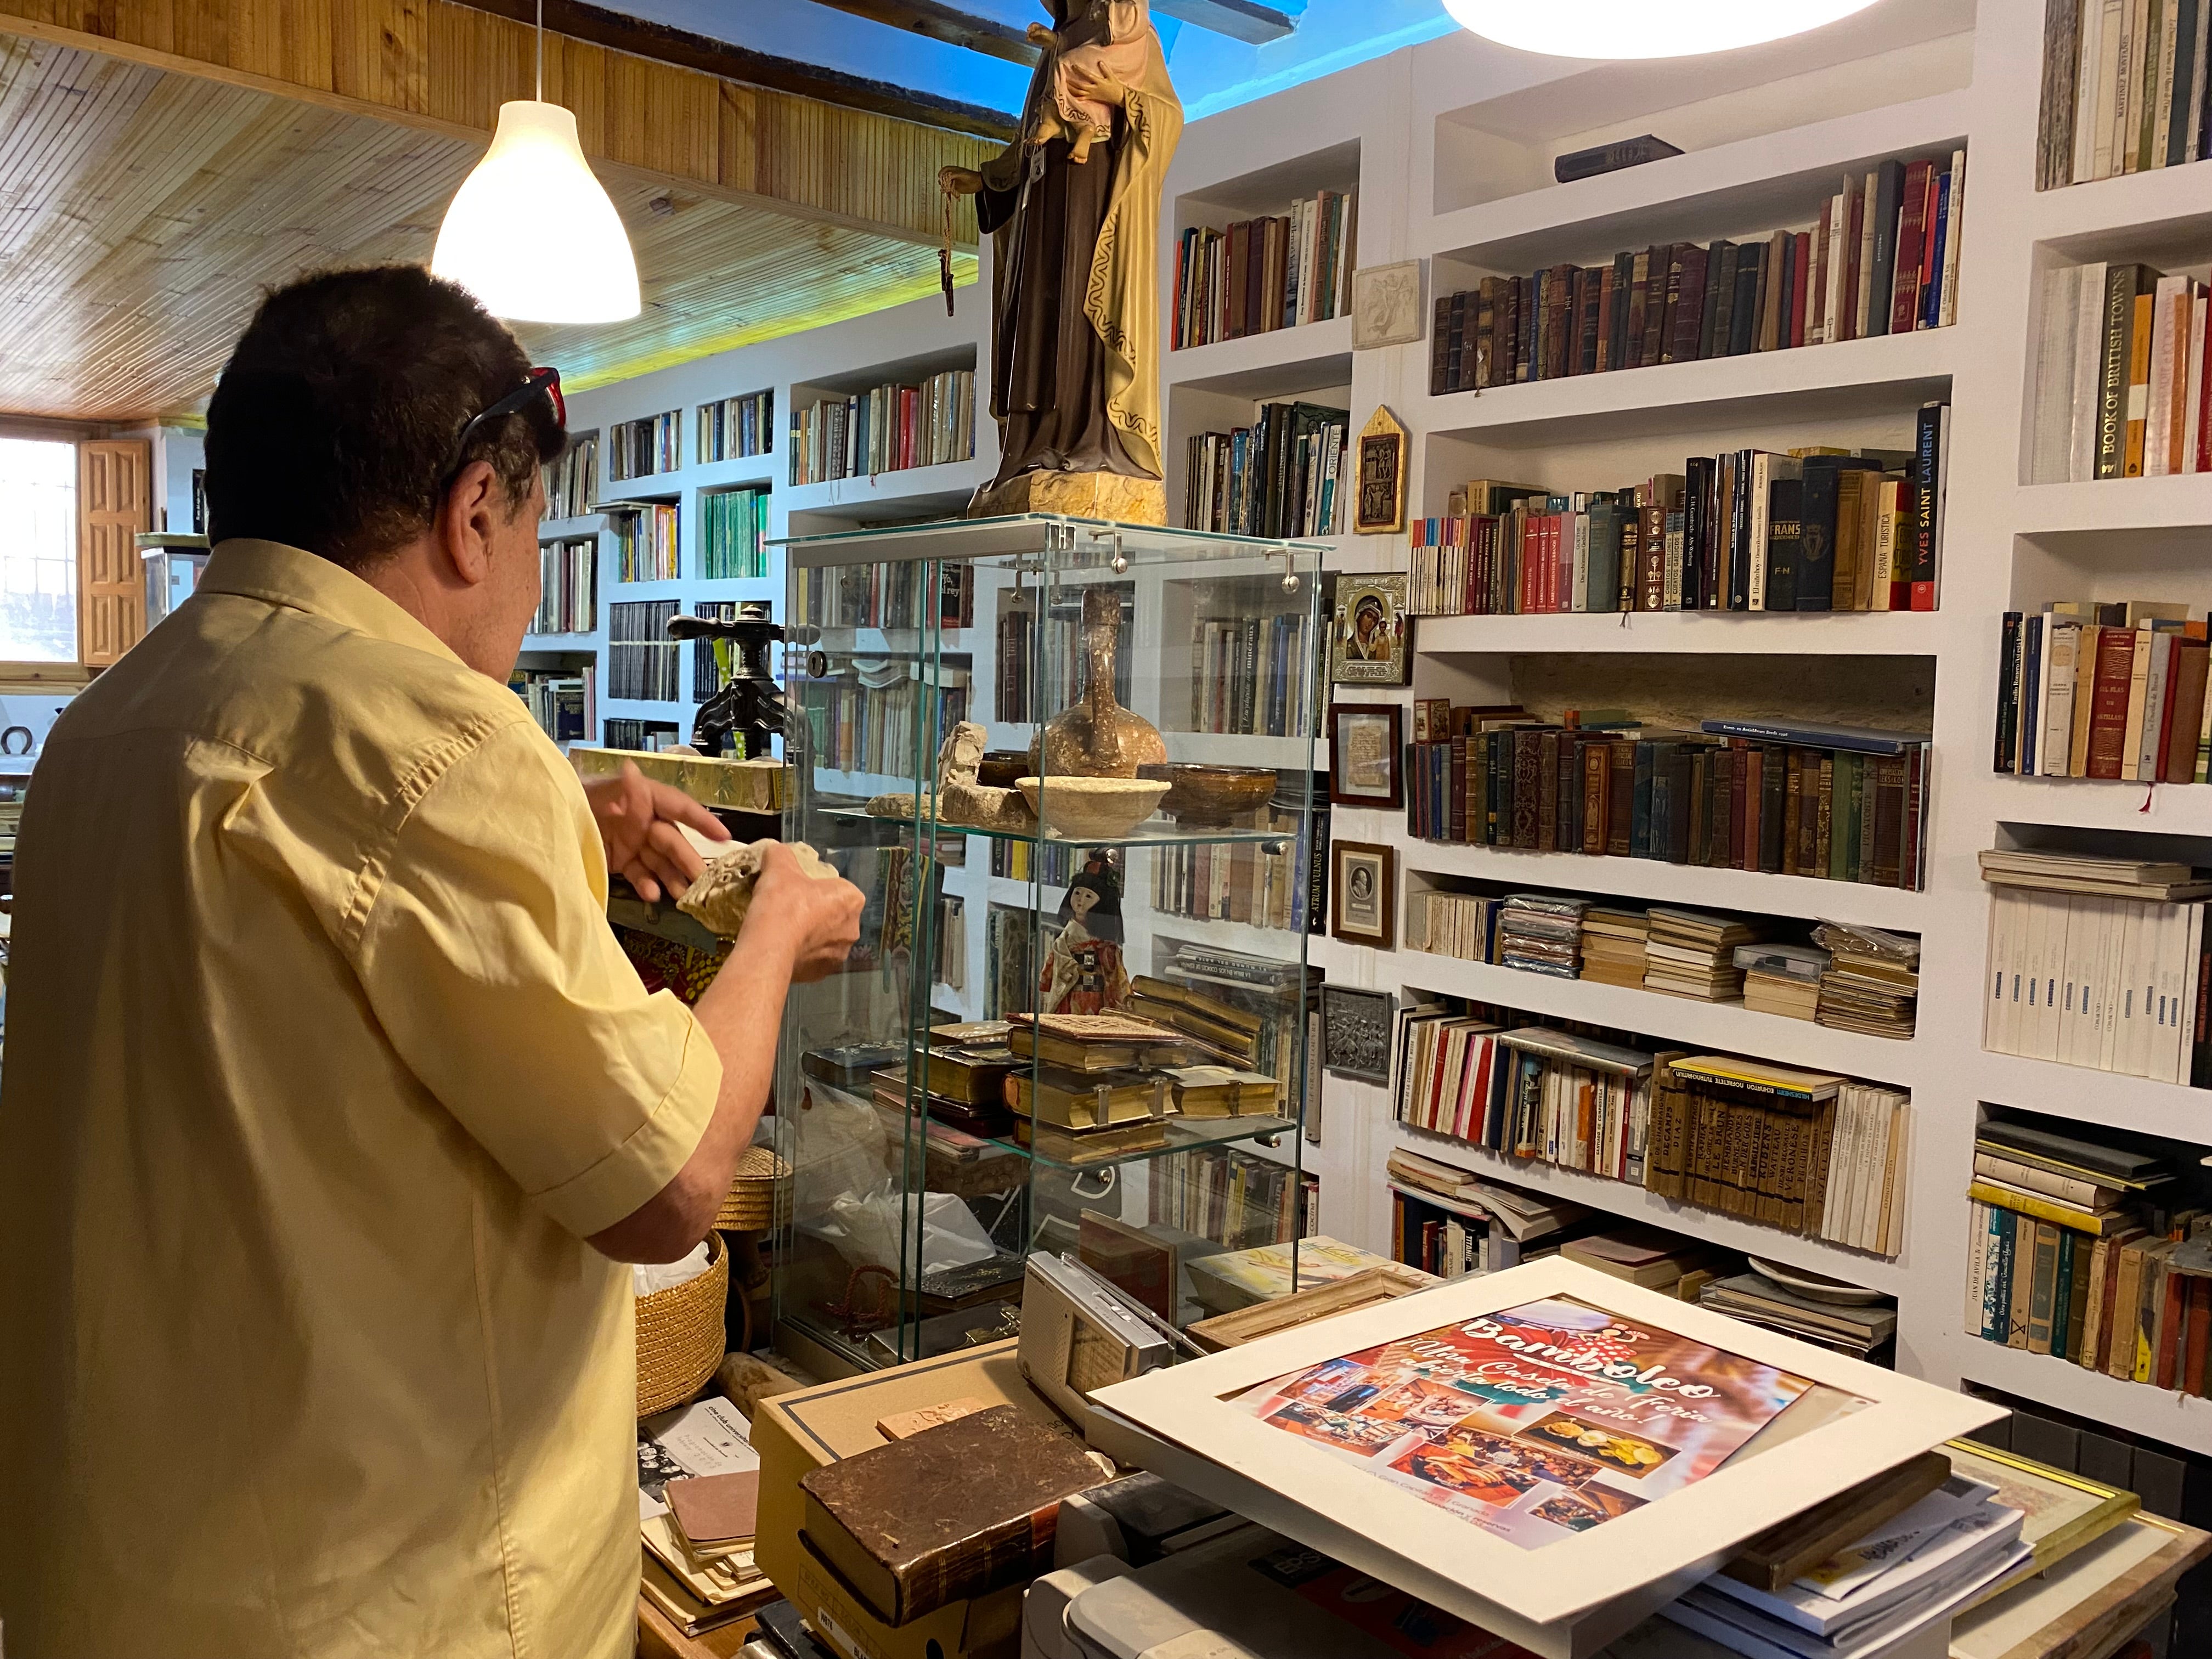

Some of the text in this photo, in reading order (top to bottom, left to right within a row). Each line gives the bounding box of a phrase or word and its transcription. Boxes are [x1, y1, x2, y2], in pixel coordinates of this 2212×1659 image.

[2117, 78, 2127, 117] MARTINEZ
[2102, 270, 2126, 455] BOOK OF BRITISH TOWNS
[1328, 428, 1340, 475] ORIENTE
[1918, 422, 1934, 566] YVES SAINT LAURENT
[1769, 524, 1801, 536] FRANS
[943, 574, 953, 585] Yo,
[1754, 562, 1762, 574] hoy
[947, 588, 960, 597] rey
[1312, 853, 1322, 883] VULNUS
[1311, 885, 1321, 913] ATRUM
[1746, 1084, 1775, 1094] ECHNATON
[1656, 1092, 1664, 1142] CHAMPAIGNE
[1663, 1106, 1673, 1156] DECAMPS
[1673, 1118, 1681, 1148] DIAZ
[1740, 1115, 1752, 1159] DER GOES
[1712, 1110, 1725, 1170] LE BRUN
[1723, 1113, 1735, 1171] REMBRANDT
[1731, 1115, 1743, 1175] BURNE-JONES
[1759, 1124, 1771, 1180] RUBENS
[1769, 1128, 1781, 1178] WATTEAU
[1778, 1122, 1791, 1189] HENRI REGNAULT
[1971, 1286, 1979, 1301] JUAN
[1459, 1317, 1720, 1399] Bamboleo
[1400, 1357, 1487, 1384] abierta
[1493, 1383, 1551, 1400] todo
[1554, 1396, 1581, 1407] el
[1476, 1361, 1576, 1392] Caseta
[1579, 1386, 1614, 1400] de
[1624, 1392, 1713, 1423] Feria
[708, 1406, 729, 1425] cine club
[1451, 1499, 1491, 1517] Granada
[1472, 1517, 1511, 1533] reservas
[820, 1611, 833, 1631] W878
